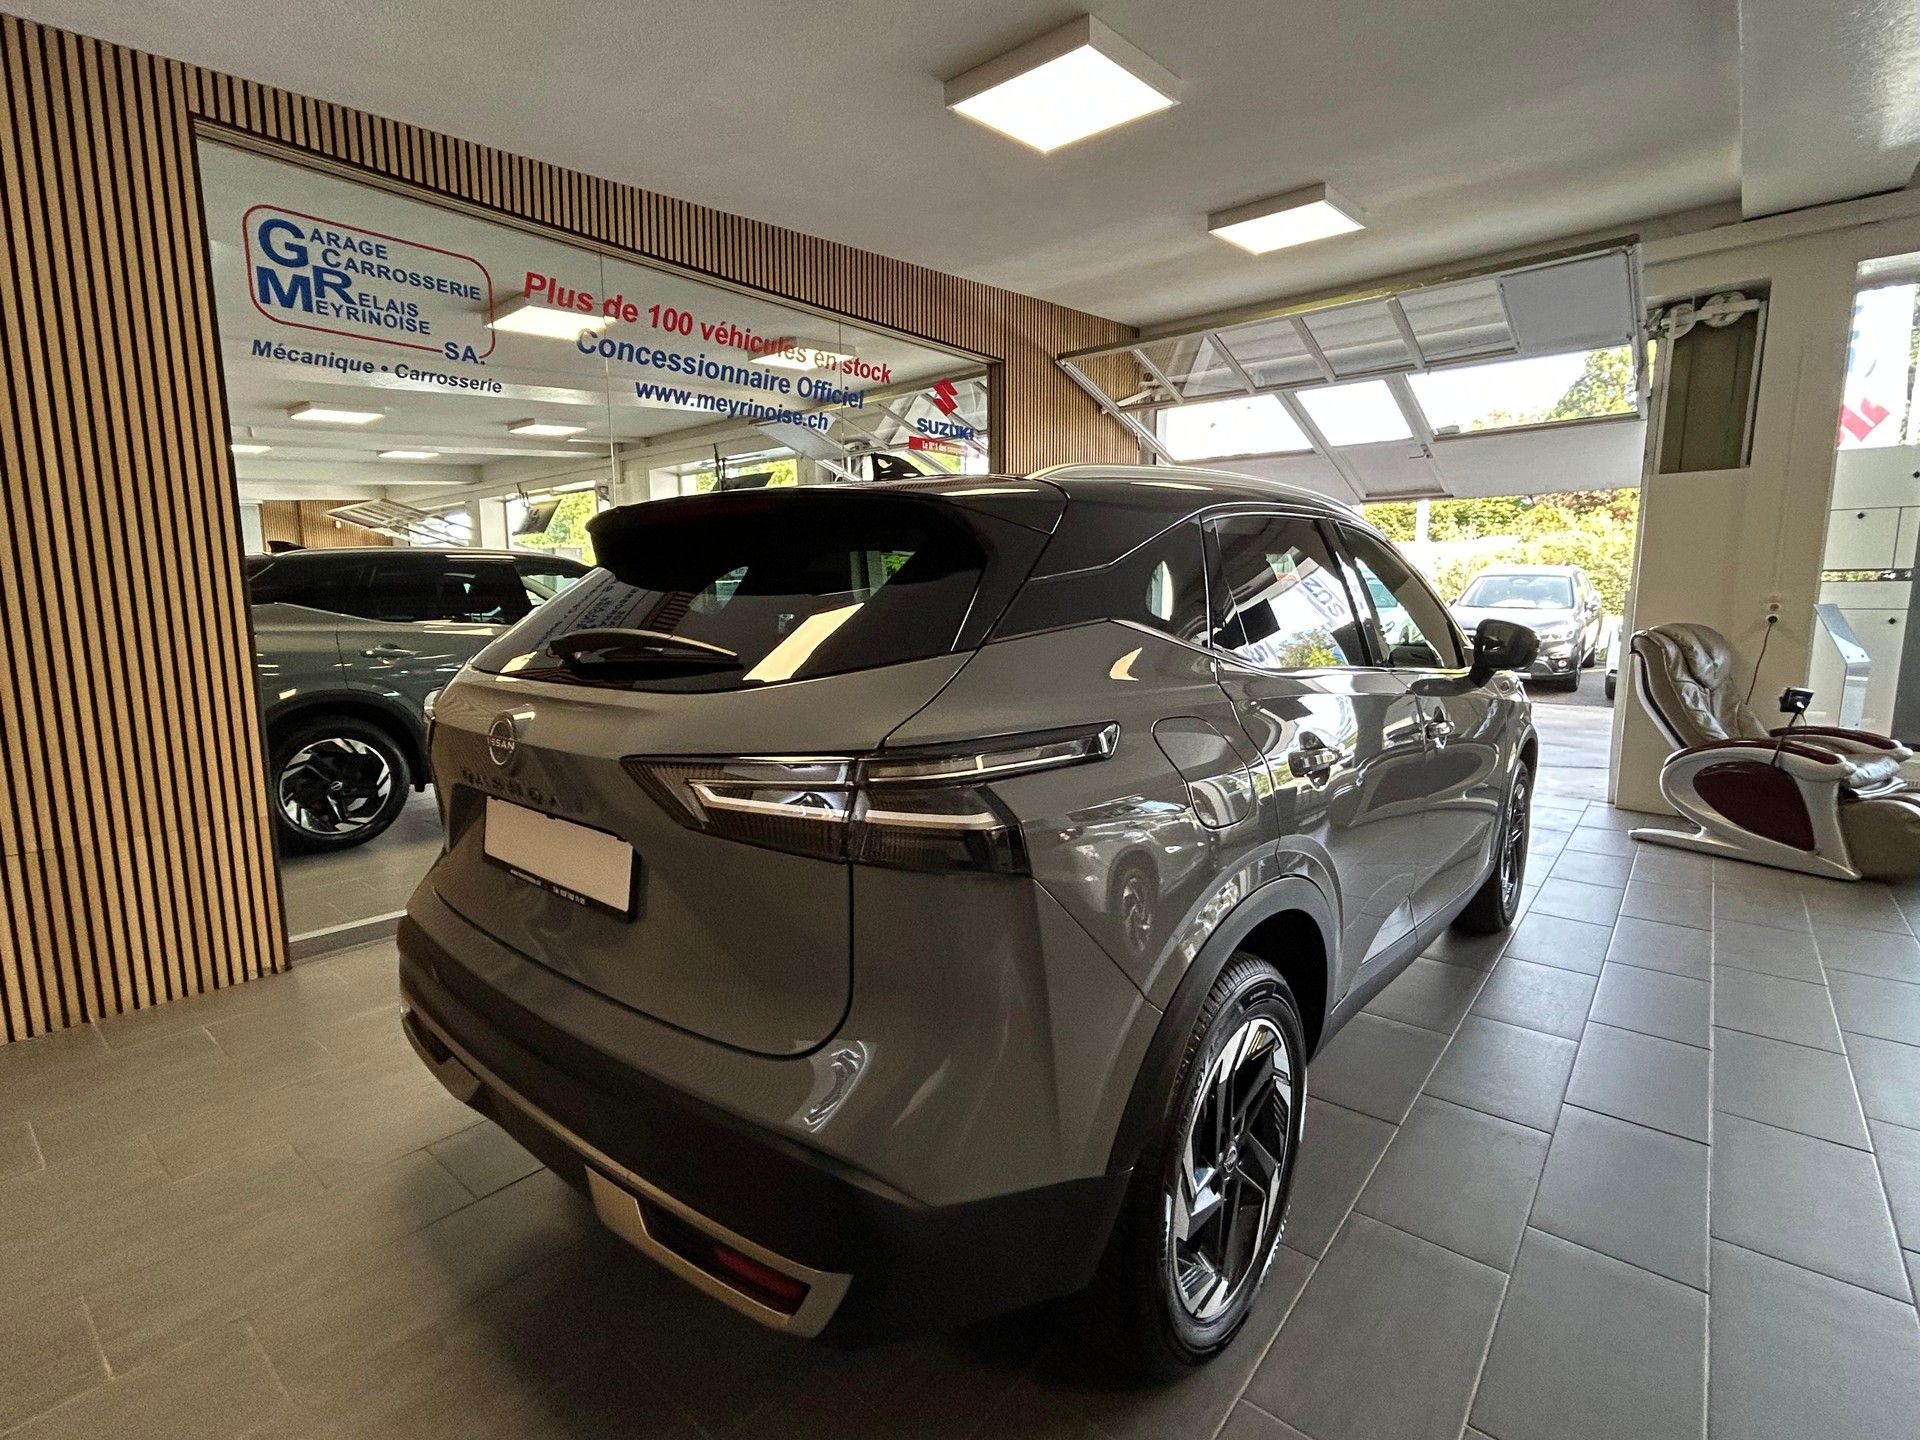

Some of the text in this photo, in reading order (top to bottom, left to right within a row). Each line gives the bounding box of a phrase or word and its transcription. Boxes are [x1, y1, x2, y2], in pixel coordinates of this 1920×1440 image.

[258, 219, 388, 268] GARAGE
[312, 265, 419, 317] RELAIS
[322, 248, 482, 300] CARROSSERIE
[256, 266, 431, 335] MEYRINOISE
[524, 271, 892, 384] Plus de 100 véhicules en stock
[252, 339, 502, 393] Mécanique Carrosserie
[577, 328, 865, 409] Concessionnaire Officiel
[635, 382, 828, 430] www.meyrinoise.ch
[917, 418, 974, 440] SUZUKI
